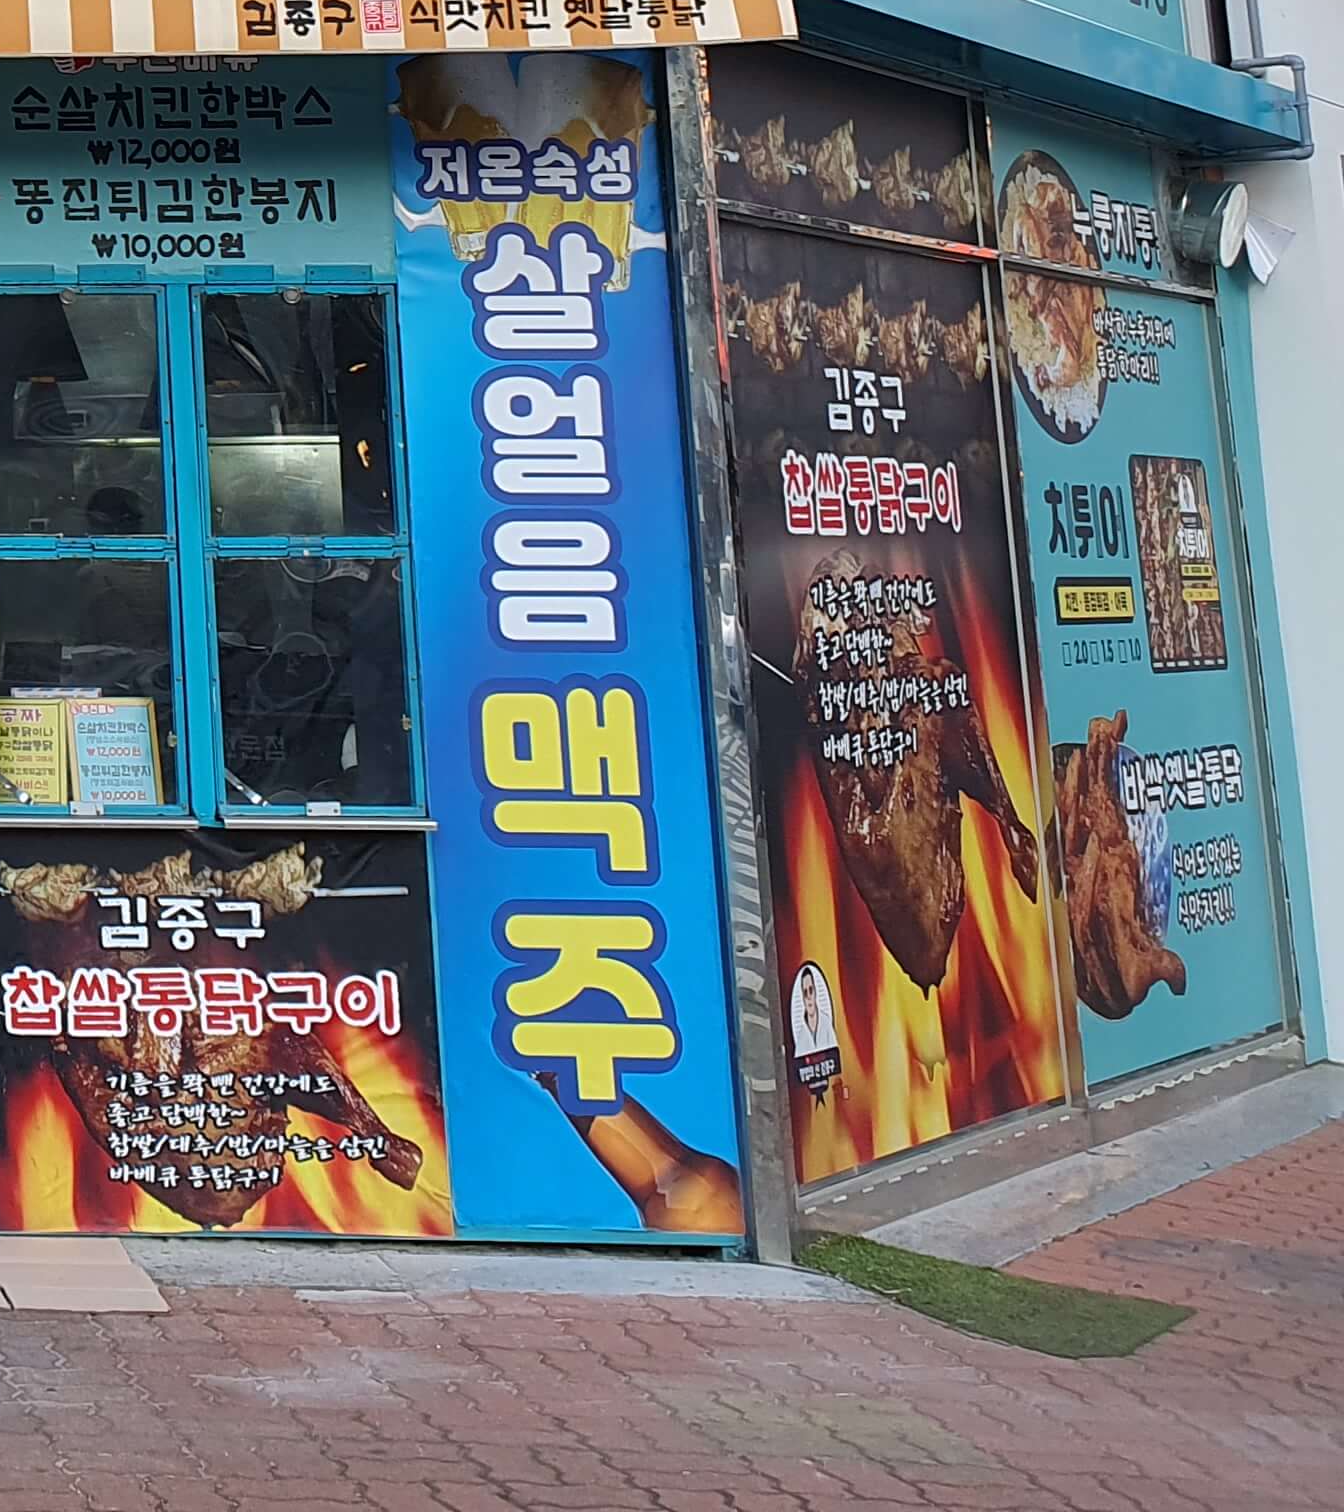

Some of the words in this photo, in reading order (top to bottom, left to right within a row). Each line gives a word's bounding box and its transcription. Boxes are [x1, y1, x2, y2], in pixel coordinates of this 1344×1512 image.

[244, 0, 355, 36] 김종구
[10, 82, 334, 131] 순살치킨한박스
[87, 137, 241, 170] ₩12,000원
[422, 144, 633, 199] 저온숙성
[13, 173, 337, 225] 똥집튀김한봉지
[91, 233, 246, 264] ₩10,000원
[1070, 192, 1162, 268] 누룽지통
[824, 366, 908, 433] 김종구
[473, 232, 620, 642] 살얼음
[782, 449, 962, 538] 찹쌀통닭구이
[1044, 482, 1129, 558] 치튀어
[811, 578, 851, 619] 기름을
[886, 579, 937, 614] 건강에도
[815, 630, 843, 671] 좋고
[845, 629, 893, 667] 담백한~
[819, 676, 942, 722] 찹쌀/대추/밤/마늘을
[944, 673, 969, 708] 삼킨
[823, 734, 864, 768] 바베큐
[868, 727, 918, 767] 통닭구이
[1120, 745, 1244, 813] 바싹옛날통닭
[1172, 840, 1208, 881] 식어도
[1207, 834, 1242, 879] 맛있는
[481, 687, 675, 1101] 맥주
[98, 893, 267, 950] 김종구
[0, 966, 402, 1037] 찹쌀통닭구이
[107, 1073, 176, 1097] 기름을
[210, 1073, 235, 1097] 뺀
[240, 1073, 336, 1096] 건강에도
[108, 1103, 154, 1127] 좋고
[161, 1103, 247, 1128] 담백한~
[109, 1134, 333, 1161] 찹쌀/대추/밤/마늘을
[338, 1135, 387, 1159] 삼킨
[110, 1164, 180, 1188] 바베큐
[187, 1165, 280, 1191] 통닭구이
